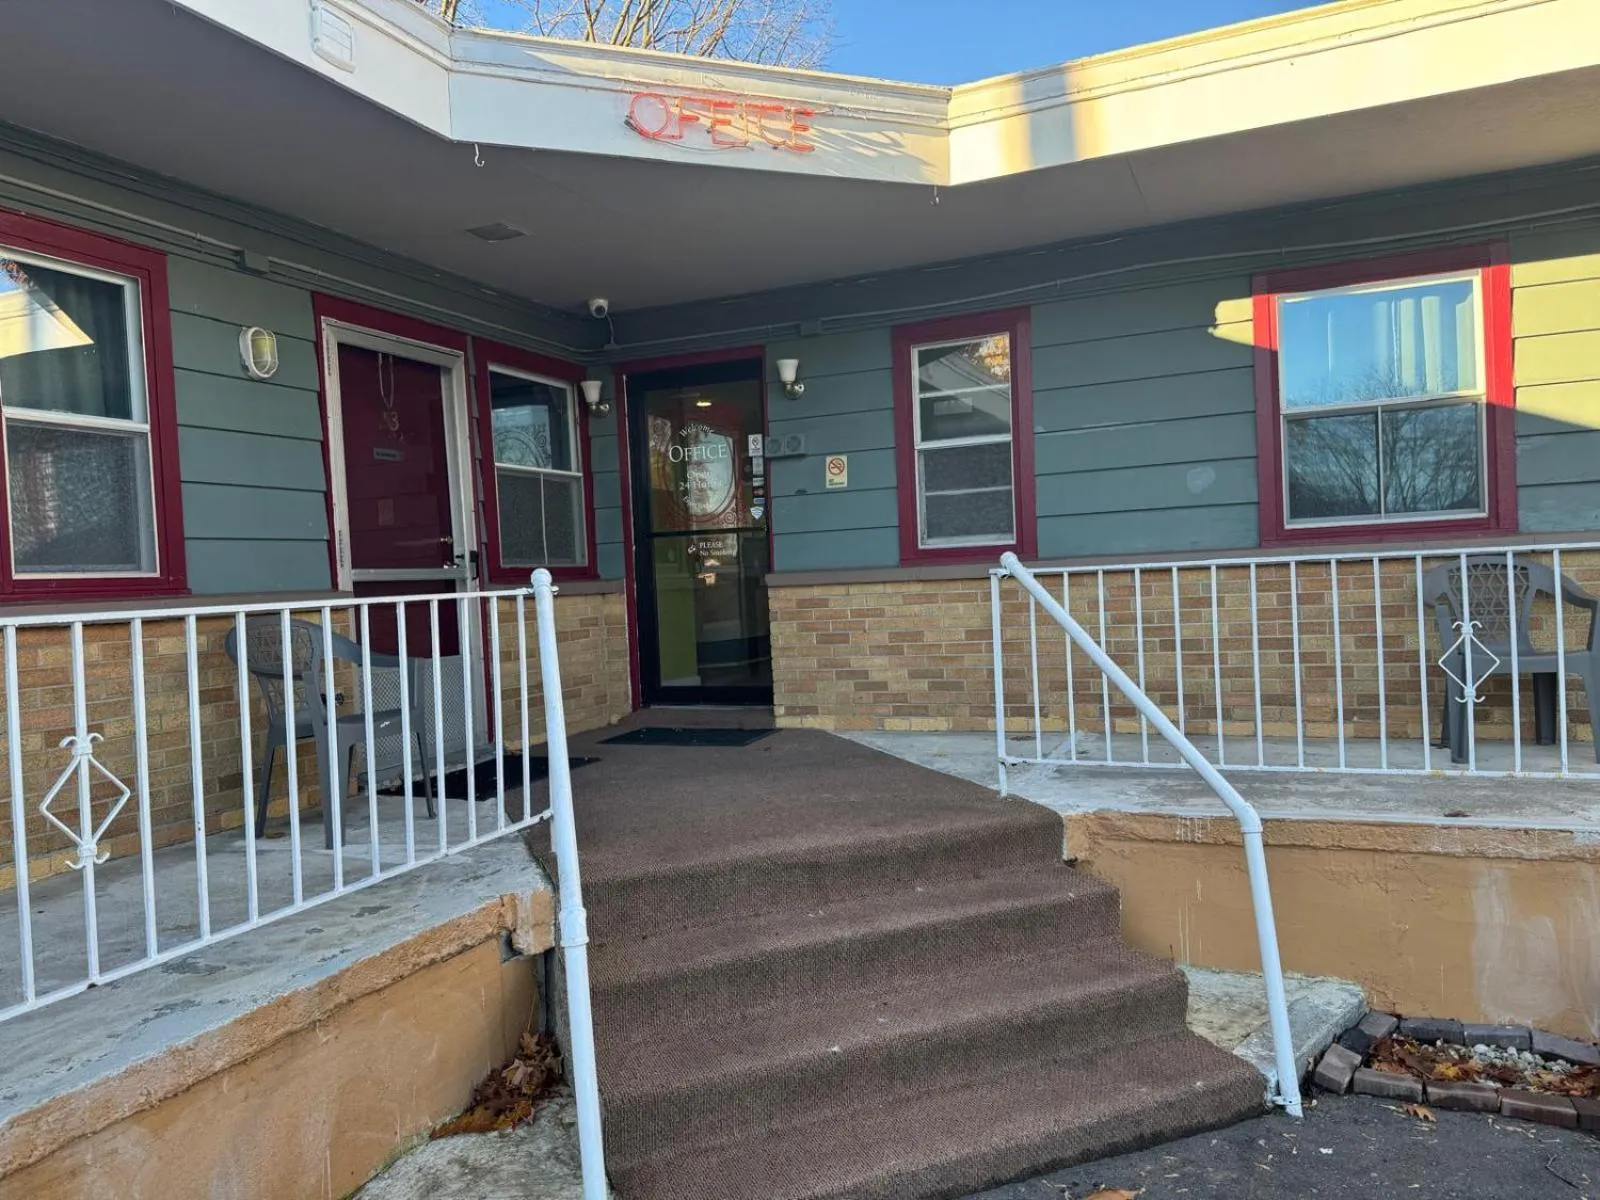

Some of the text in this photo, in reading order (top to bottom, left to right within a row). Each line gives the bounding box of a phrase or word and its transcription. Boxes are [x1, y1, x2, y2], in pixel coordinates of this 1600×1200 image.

[629, 92, 815, 152] OFFICE
[680, 424, 716, 437] Welcome
[669, 445, 728, 462] OFFICE
[679, 481, 692, 490] 24
[700, 541, 724, 549] PLEASE
